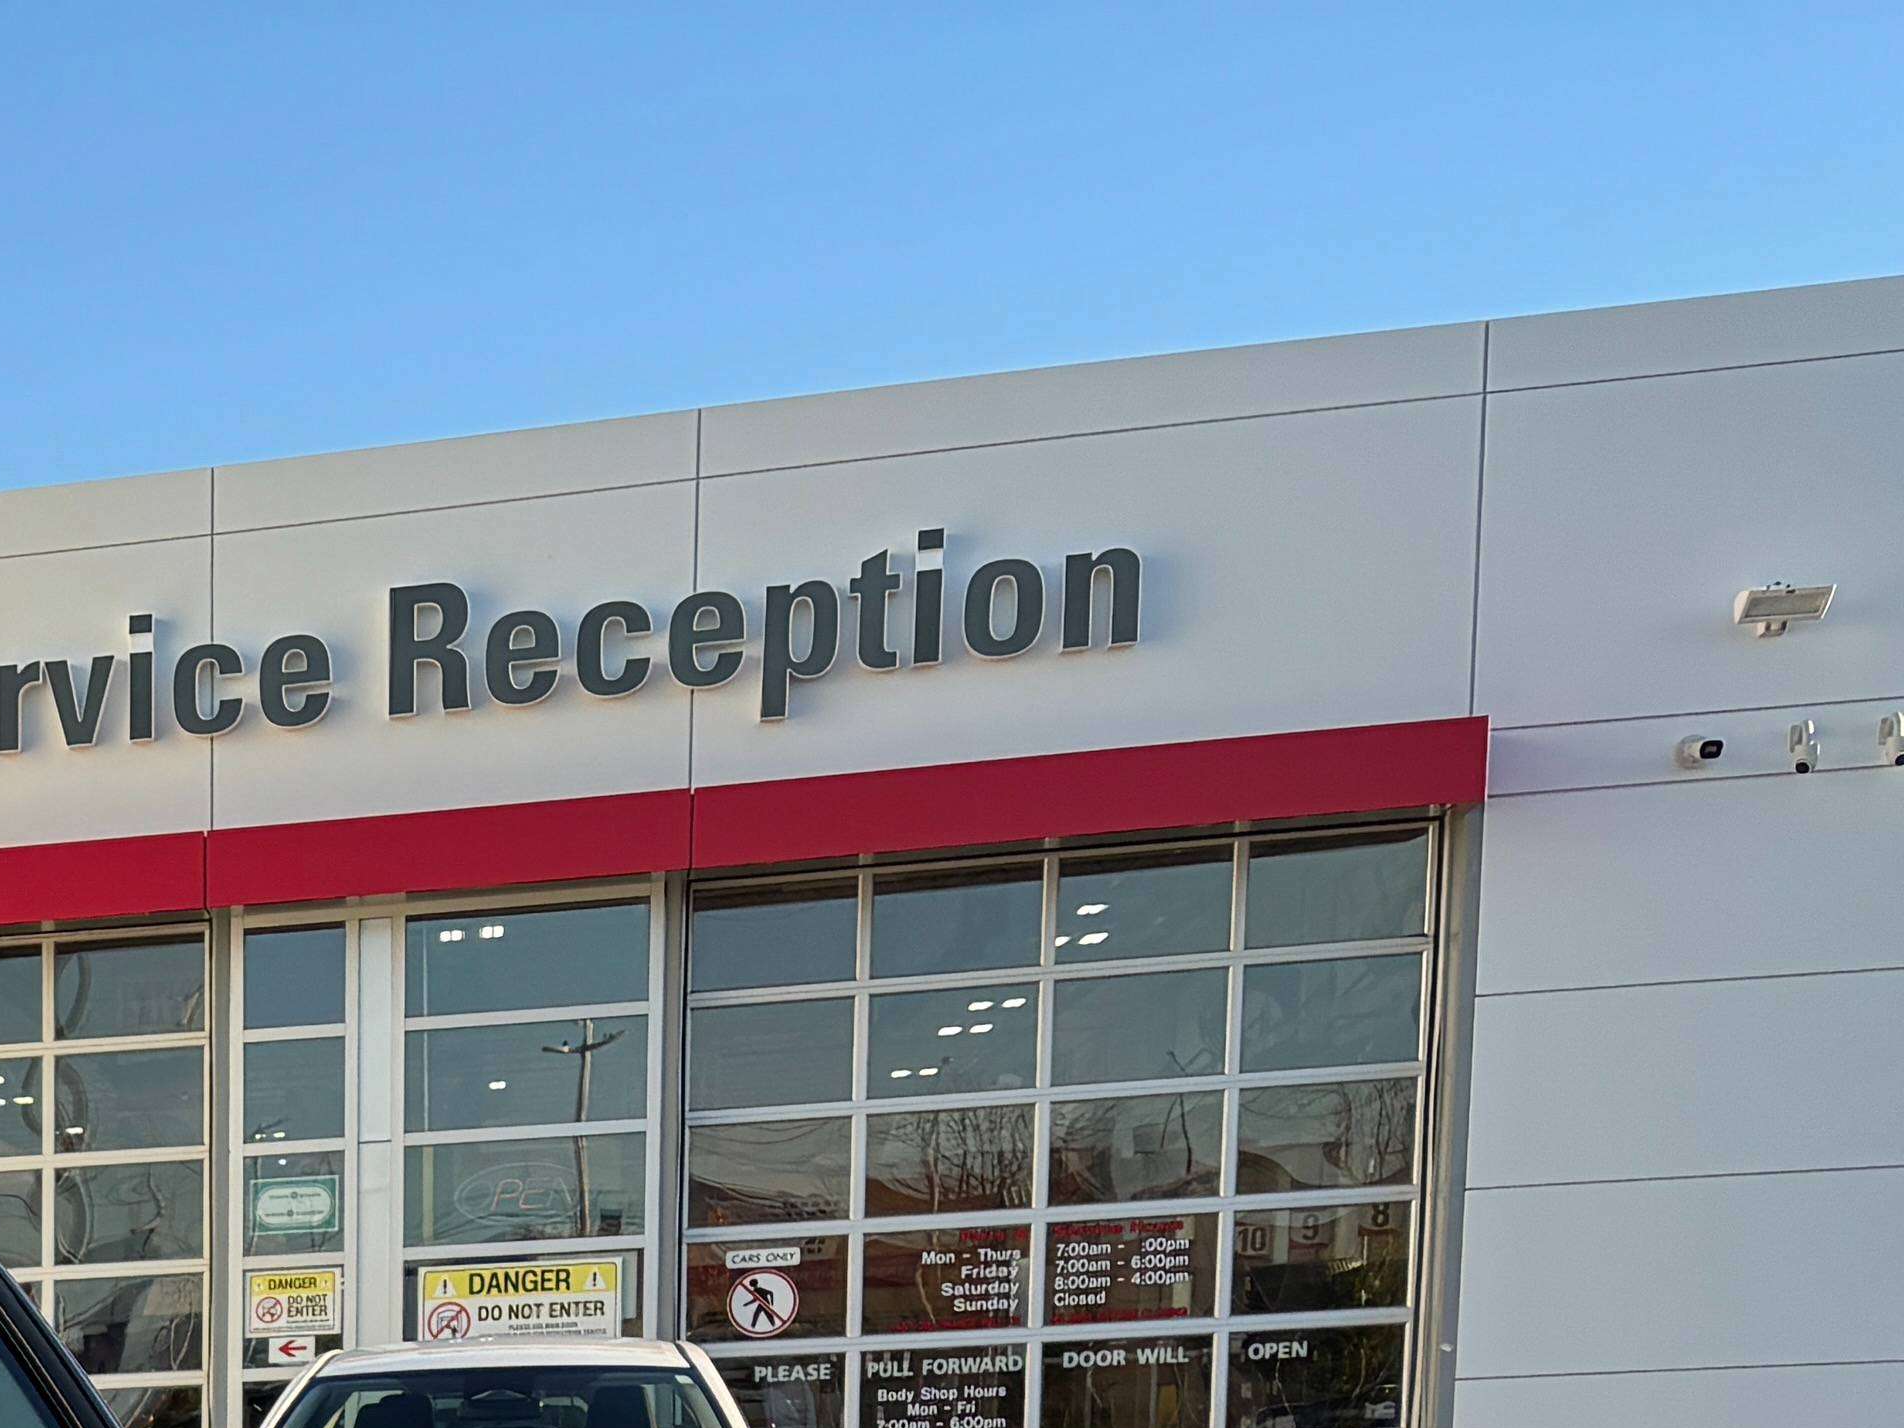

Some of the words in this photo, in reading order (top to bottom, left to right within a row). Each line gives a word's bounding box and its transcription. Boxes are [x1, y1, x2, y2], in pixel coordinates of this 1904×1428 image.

[388, 527, 1141, 722] Reception
[1301, 1213, 1320, 1241] 9
[1238, 1226, 1268, 1253] 10
[731, 1252, 760, 1265] CARS
[765, 1251, 796, 1264] ONLY
[921, 1250, 955, 1265] Mon
[977, 1247, 1021, 1262] Thurs
[1056, 1242, 1111, 1259] 7:00am
[960, 1263, 1019, 1280] Friday
[1055, 1258, 1111, 1274] 7:00am
[1130, 1254, 1189, 1270] 6:00pm
[268, 1276, 317, 1291] DANGER
[468, 1268, 571, 1295] DANGER
[941, 1280, 1019, 1297] Saturday
[1054, 1274, 1111, 1290] 8:00am
[1130, 1270, 1189, 1286] 4:00pm
[287, 1294, 304, 1306] DO
[305, 1293, 328, 1304] NOT
[477, 1305, 503, 1322] DO
[508, 1303, 543, 1320] NOT
[549, 1300, 605, 1318] ENTER
[953, 1296, 1019, 1313] Sunday
[1054, 1290, 1106, 1307] Closed
[287, 1305, 328, 1318] ENTER
[754, 1363, 831, 1383] PLEASE
[867, 1361, 914, 1379] PULL
[922, 1355, 1023, 1375] FORWARD
[1062, 1348, 1126, 1369] DOOR
[1136, 1345, 1189, 1365] WILL
[1247, 1340, 1308, 1360] OPEN
[877, 1388, 914, 1403] Body
[921, 1386, 958, 1402] Shop
[964, 1384, 1007, 1398] Hours
[907, 1402, 937, 1416] Mon
[957, 1400, 976, 1414] Fri
